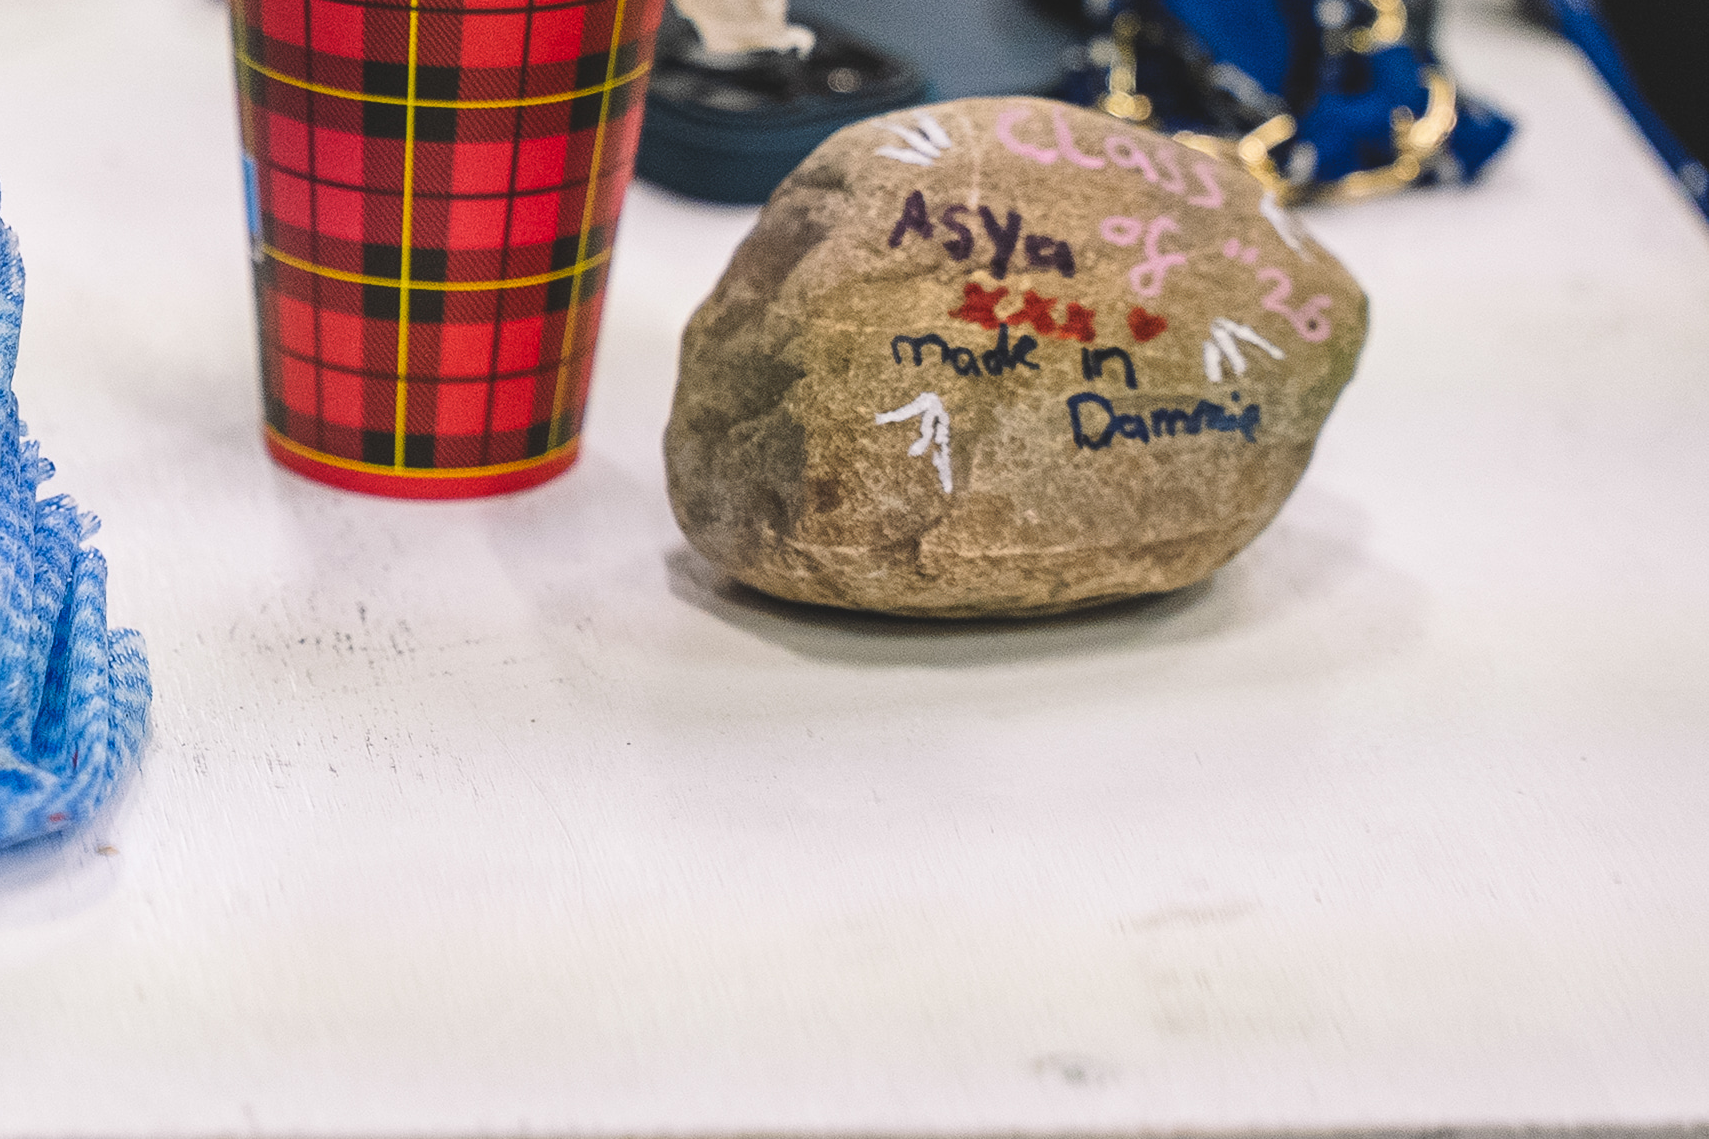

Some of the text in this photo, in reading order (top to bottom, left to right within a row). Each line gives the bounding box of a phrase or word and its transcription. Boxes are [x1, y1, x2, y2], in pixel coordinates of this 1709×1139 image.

[1099, 214, 1187, 298] of
[890, 322, 1040, 377] made
[1067, 391, 1262, 450] Dammie
